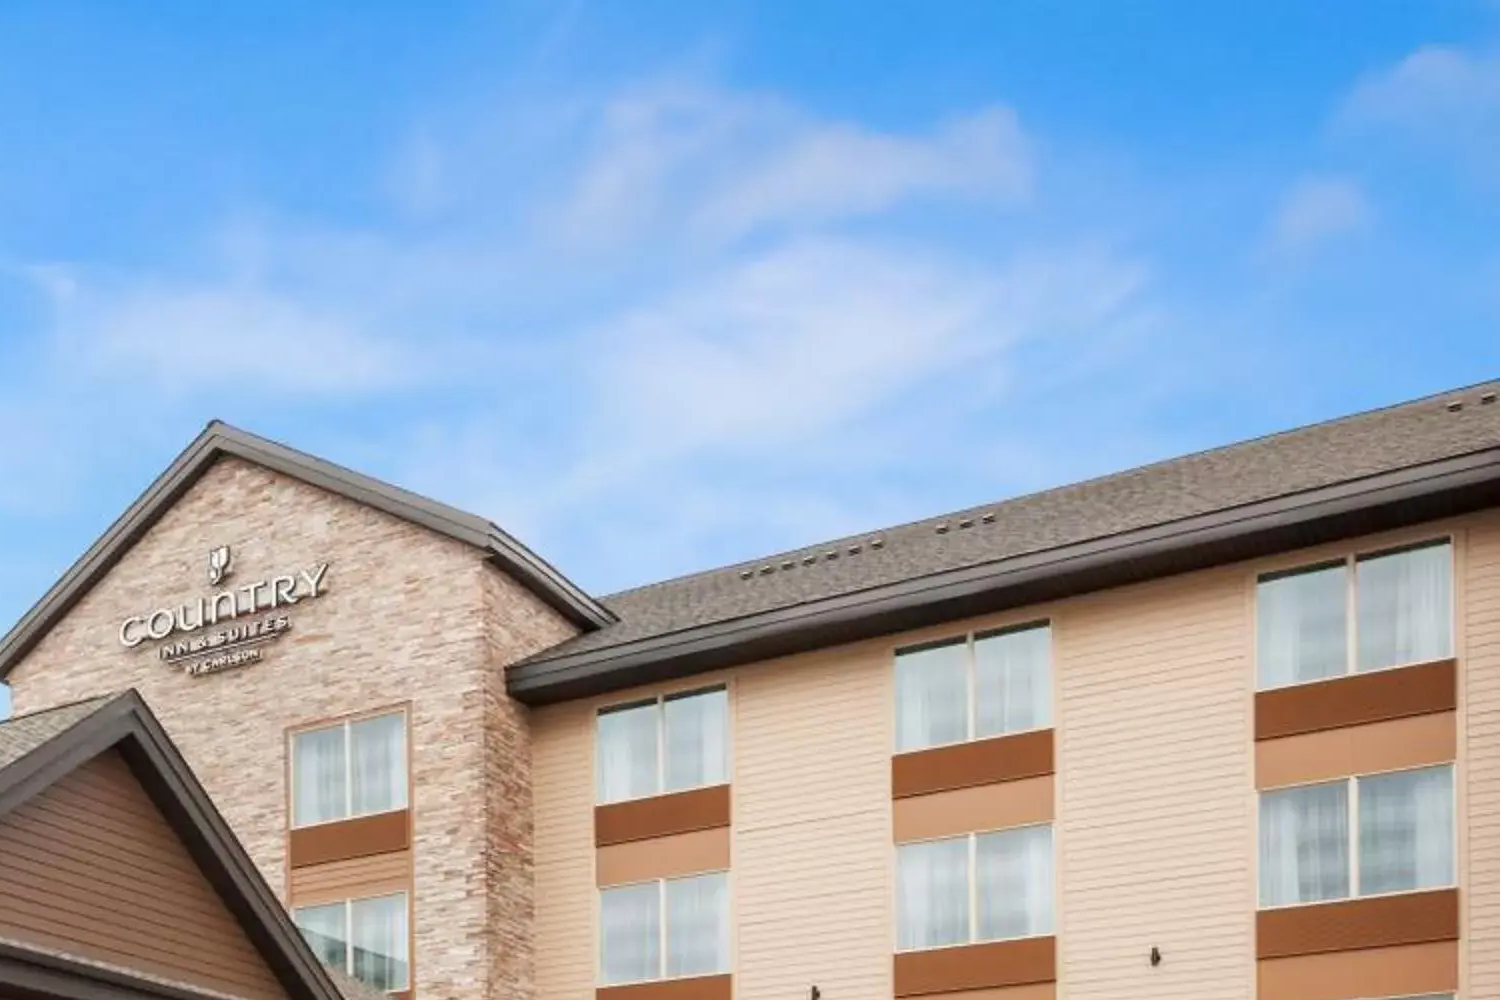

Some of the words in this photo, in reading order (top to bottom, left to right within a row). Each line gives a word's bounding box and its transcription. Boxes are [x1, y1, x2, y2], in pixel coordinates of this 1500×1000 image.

[119, 563, 329, 648] COUNTRY
[159, 640, 191, 660] INN
[198, 635, 211, 650] &
[215, 615, 292, 643] SUITES
[203, 649, 263, 672] CARLSON
